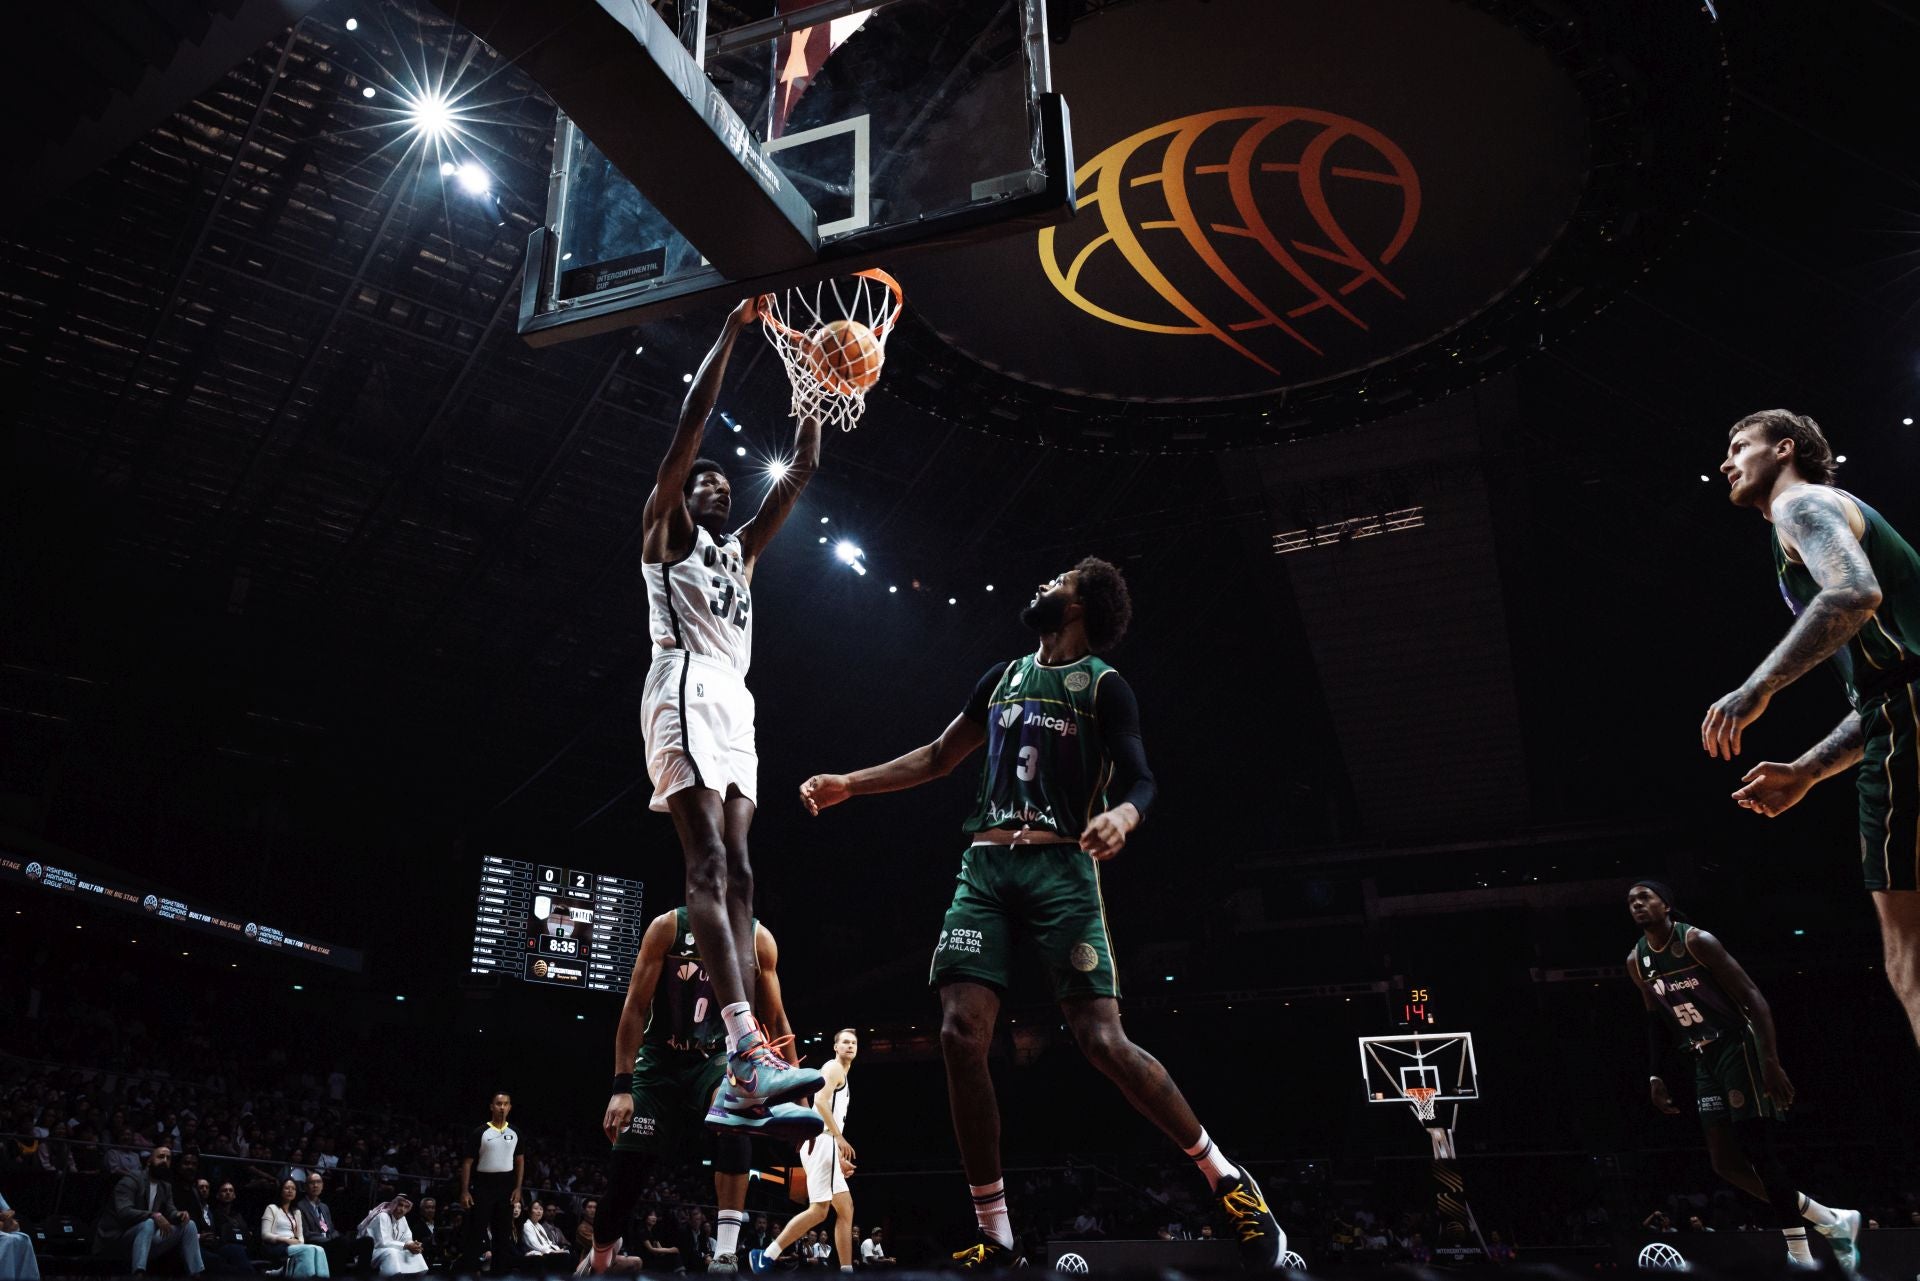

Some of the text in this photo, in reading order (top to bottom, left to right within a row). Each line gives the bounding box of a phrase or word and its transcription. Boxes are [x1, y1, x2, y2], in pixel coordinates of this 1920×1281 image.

[596, 262, 658, 283] INTERCONTINENTAL
[596, 282, 609, 290] CUP
[710, 576, 750, 631] 32
[1016, 745, 1039, 782] 3
[42, 872, 76, 885] CHAMPIONS
[43, 865, 78, 879] BASKETBALL
[545, 869, 554, 881] 0
[576, 875, 585, 887] 2
[952, 928, 983, 939] COSTA
[549, 939, 576, 954] 8:35
[966, 938, 982, 947] SOL
[1411, 989, 1428, 1002] 35
[694, 997, 708, 1023] 0
[1405, 1004, 1424, 1021] 14
[1673, 1002, 1704, 1027] 55
[633, 1116, 656, 1126] COSTA
